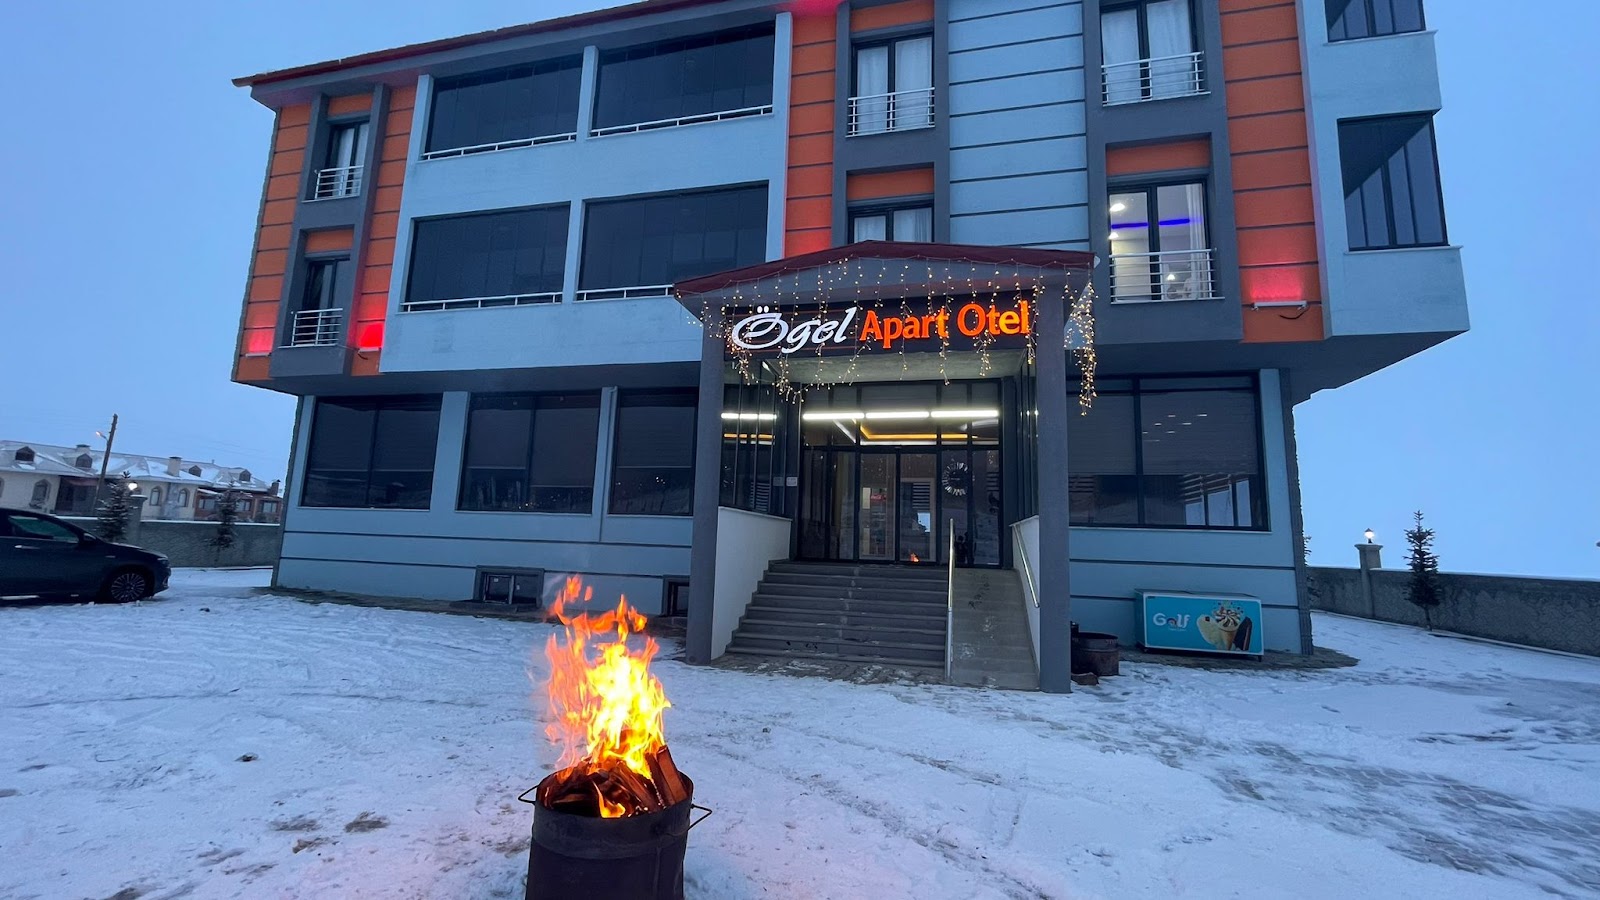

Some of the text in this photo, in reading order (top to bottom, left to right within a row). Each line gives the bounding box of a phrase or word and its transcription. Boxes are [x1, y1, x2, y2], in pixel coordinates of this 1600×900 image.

[731, 300, 1029, 354] Ögel Apart Otel
